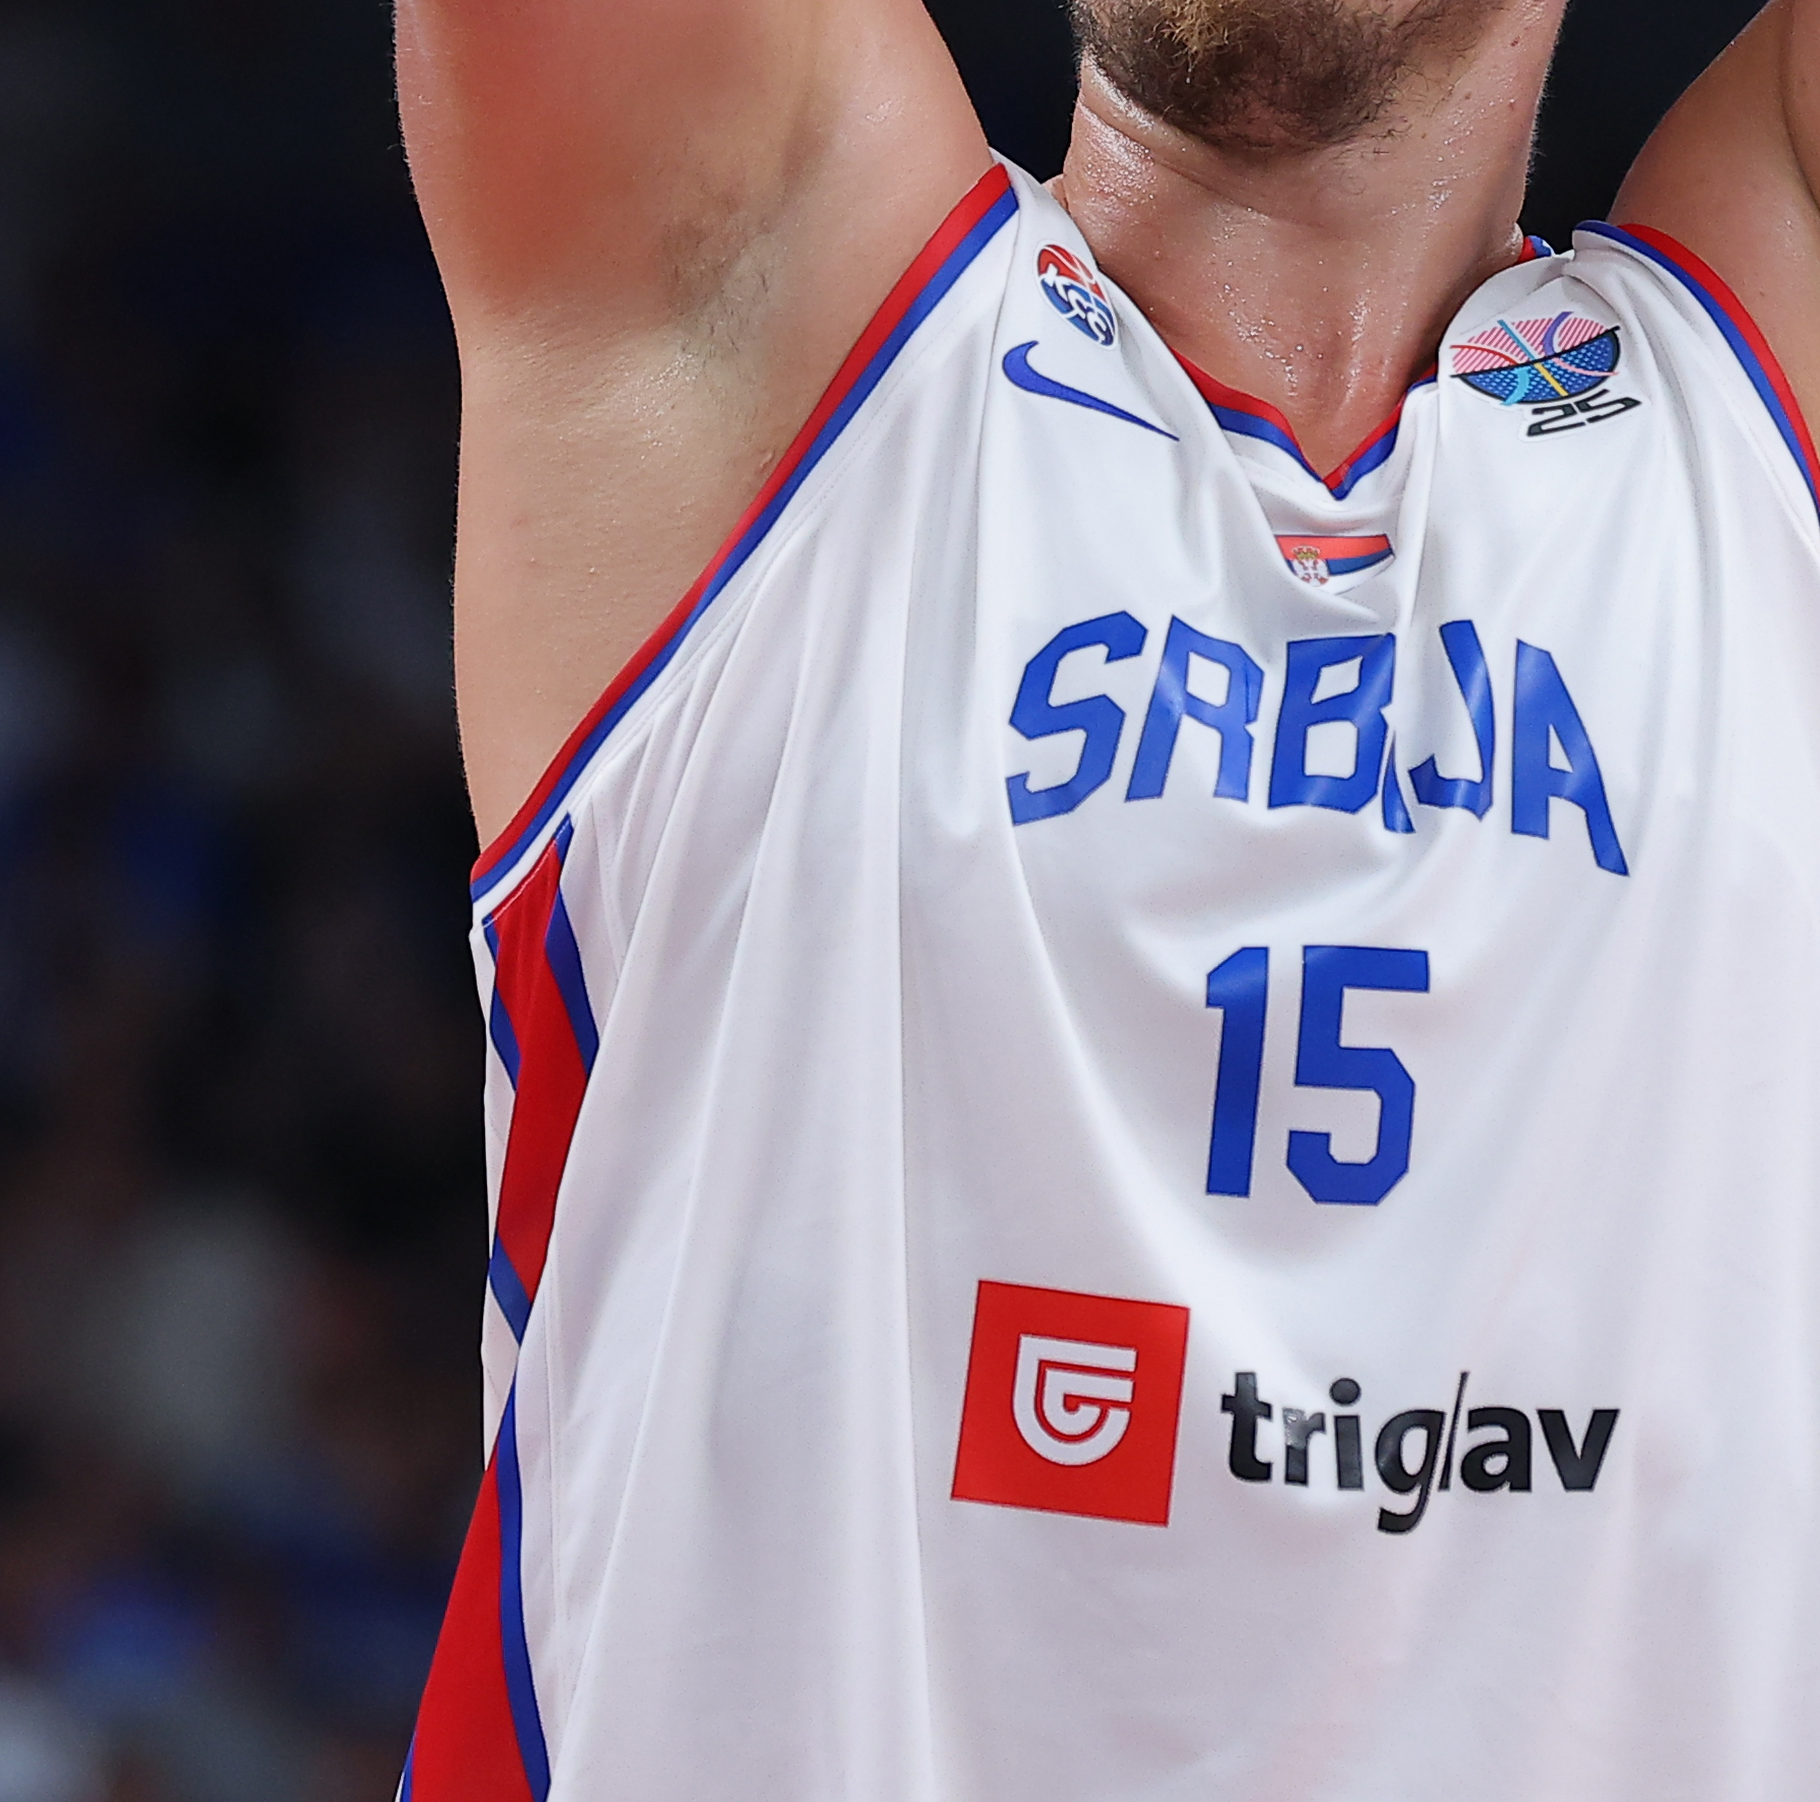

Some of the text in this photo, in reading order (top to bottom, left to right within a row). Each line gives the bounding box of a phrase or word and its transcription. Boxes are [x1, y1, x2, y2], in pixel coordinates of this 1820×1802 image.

[1527, 388, 1643, 438] 25
[1005, 609, 1630, 877] SRBJA
[1205, 944, 1431, 1207] 15
